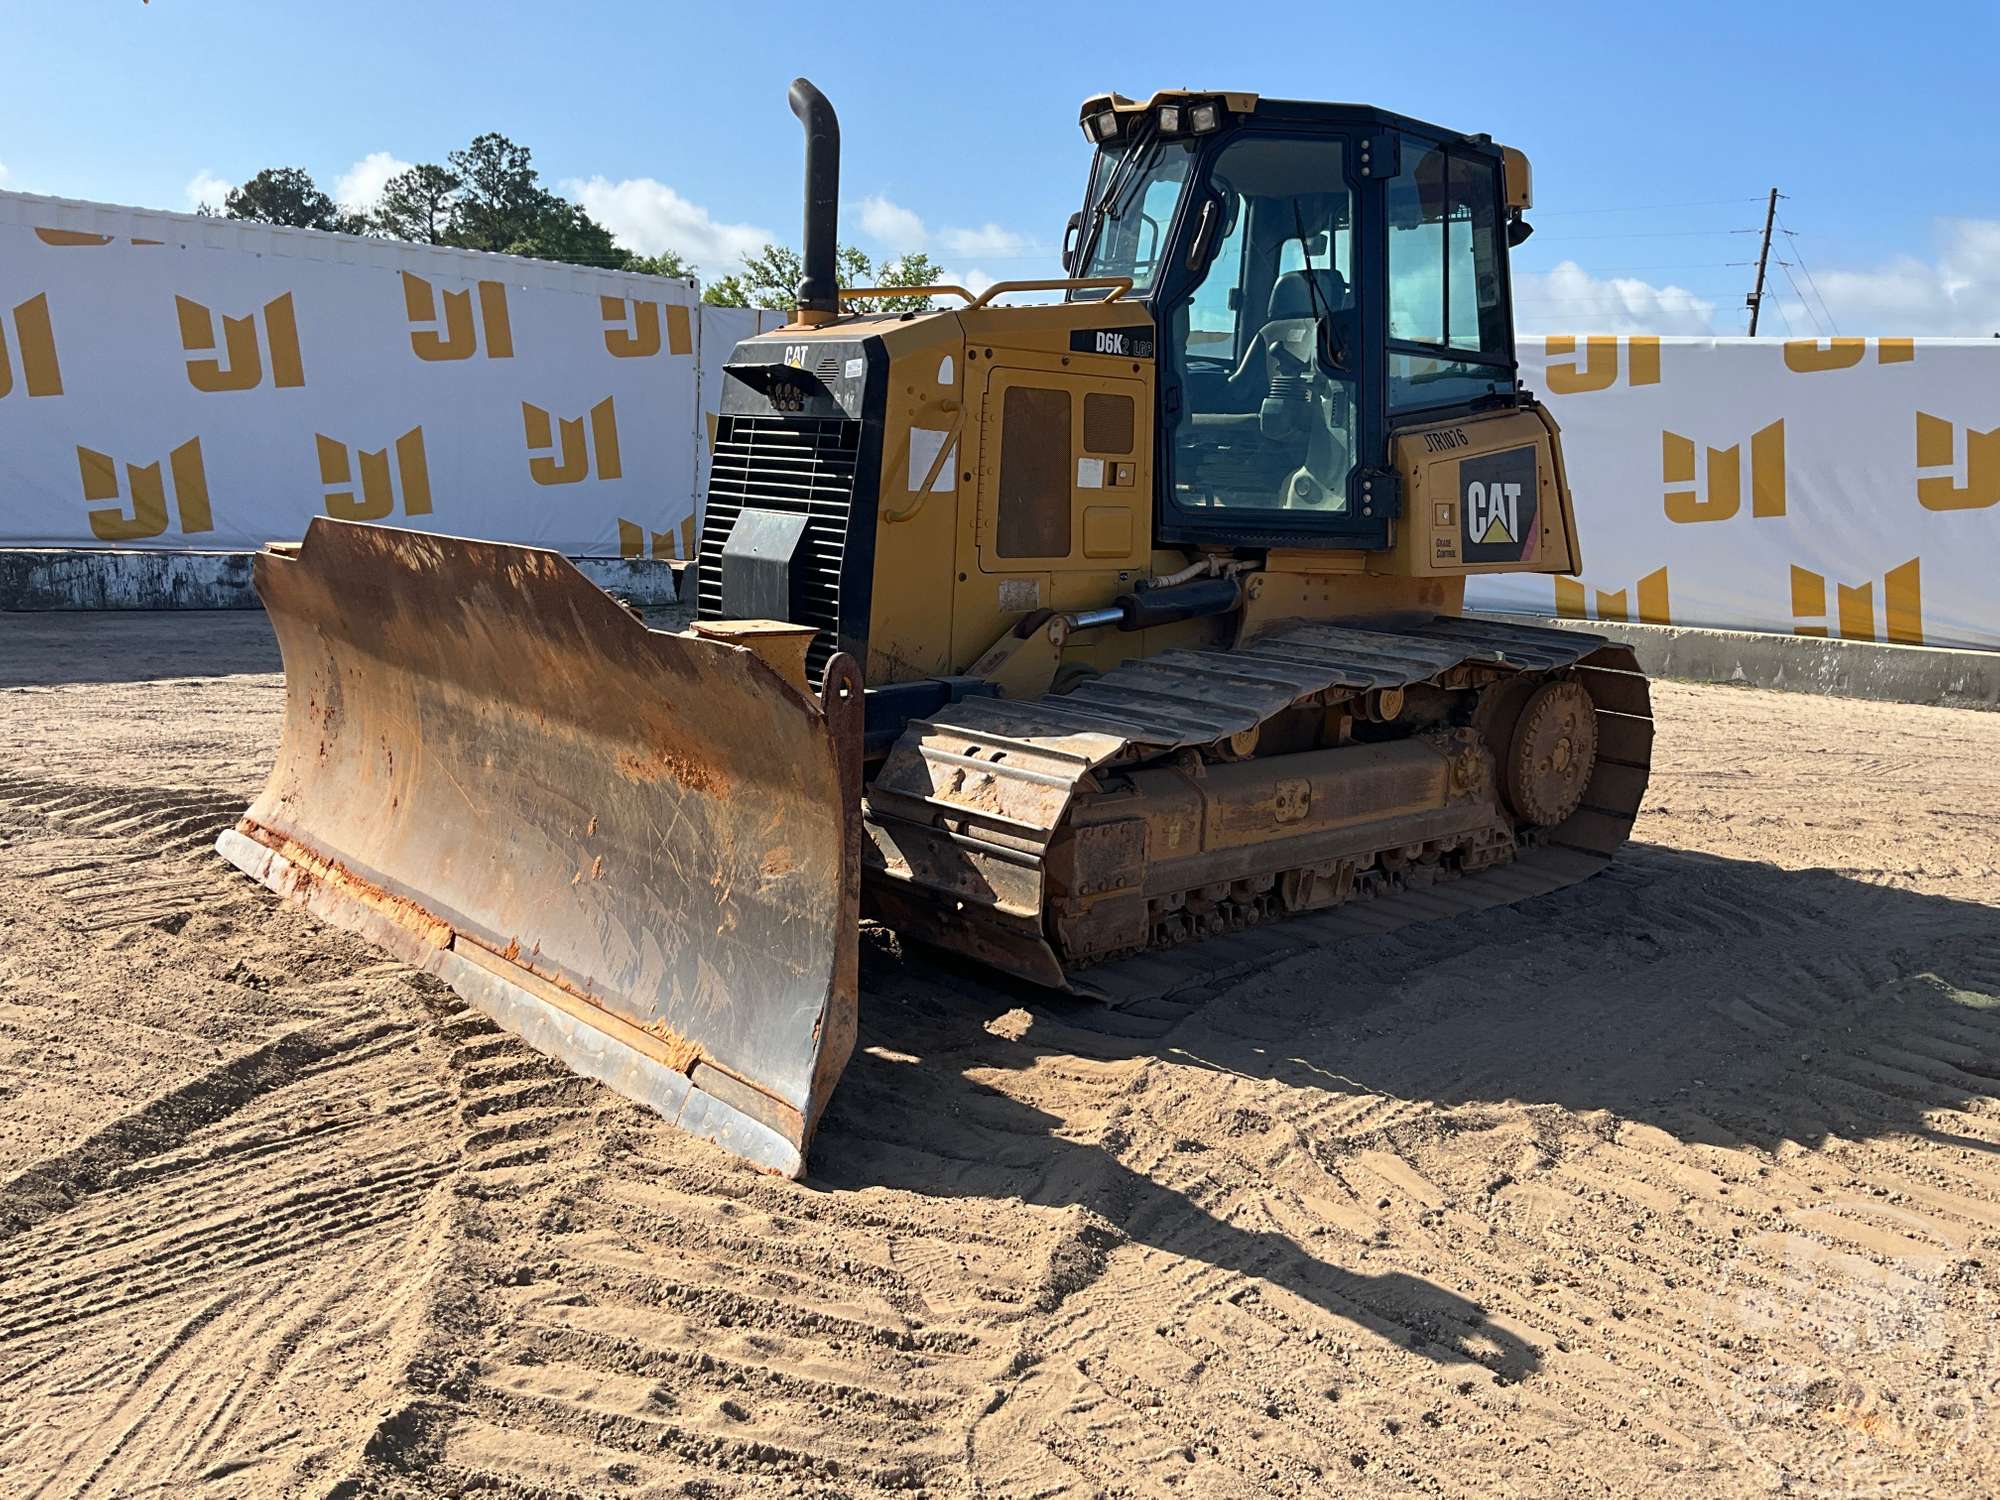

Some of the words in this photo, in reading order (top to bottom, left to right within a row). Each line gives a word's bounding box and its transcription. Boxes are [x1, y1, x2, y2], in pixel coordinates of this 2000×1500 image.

[784, 345, 809, 369] CAT
[1424, 428, 1469, 453] JTR1076
[1468, 481, 1521, 544] CAT
